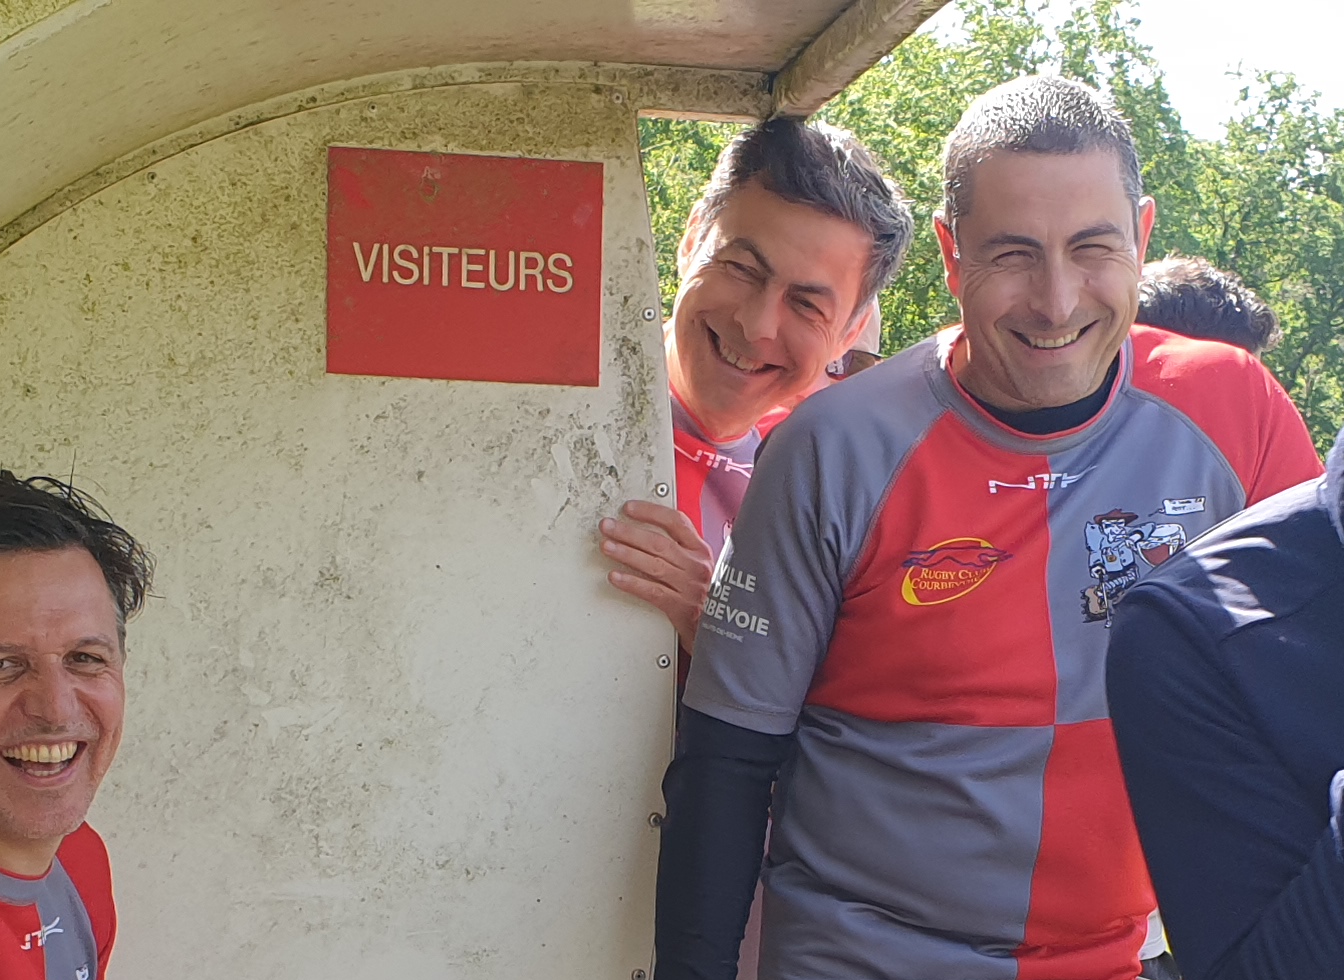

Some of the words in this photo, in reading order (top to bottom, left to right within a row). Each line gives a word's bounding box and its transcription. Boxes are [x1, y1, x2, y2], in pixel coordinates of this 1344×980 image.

[352, 241, 574, 293] VISITEURS
[712, 581, 732, 602] DE
[720, 562, 757, 593] VILLE
